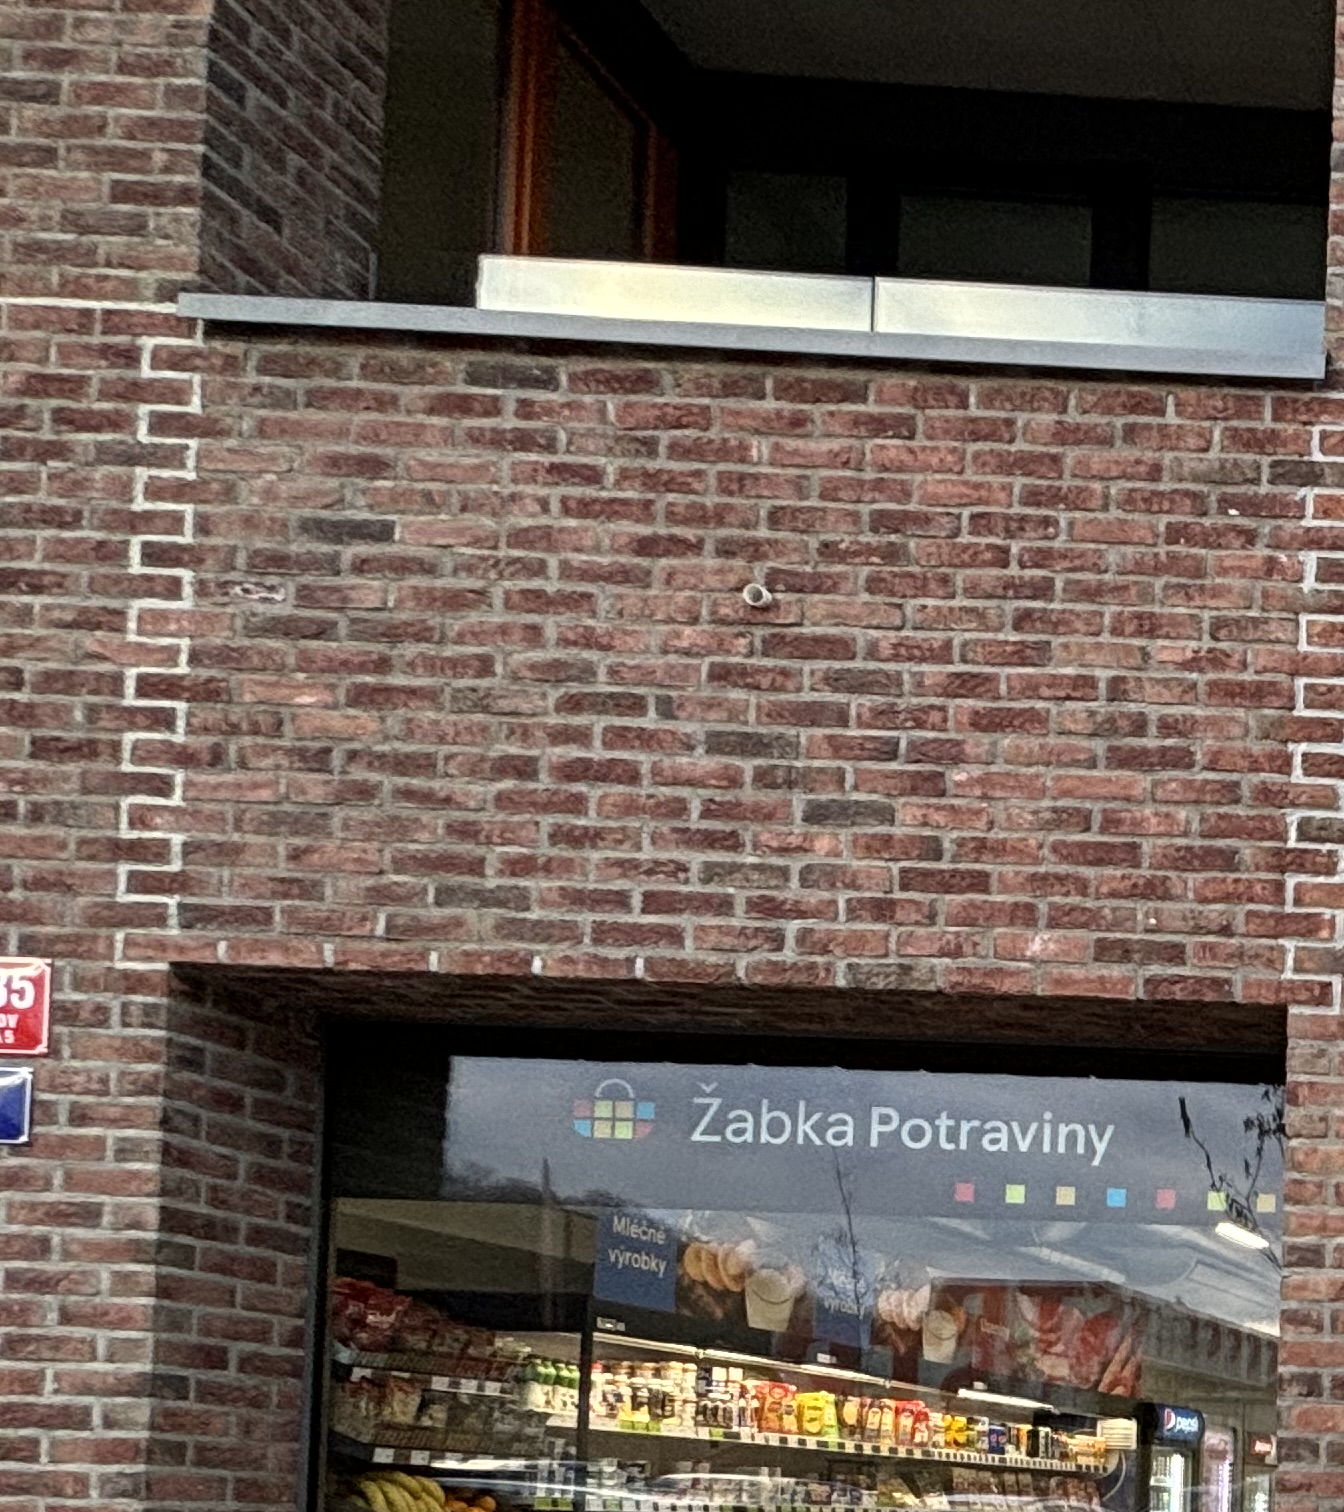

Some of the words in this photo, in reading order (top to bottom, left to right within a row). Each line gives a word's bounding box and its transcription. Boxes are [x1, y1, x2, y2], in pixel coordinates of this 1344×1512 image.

[691, 1081, 854, 1147] Žabka
[869, 1105, 1115, 1166] Potraviny
[612, 1215, 666, 1245] Mléčné
[608, 1245, 668, 1278] výrobky
